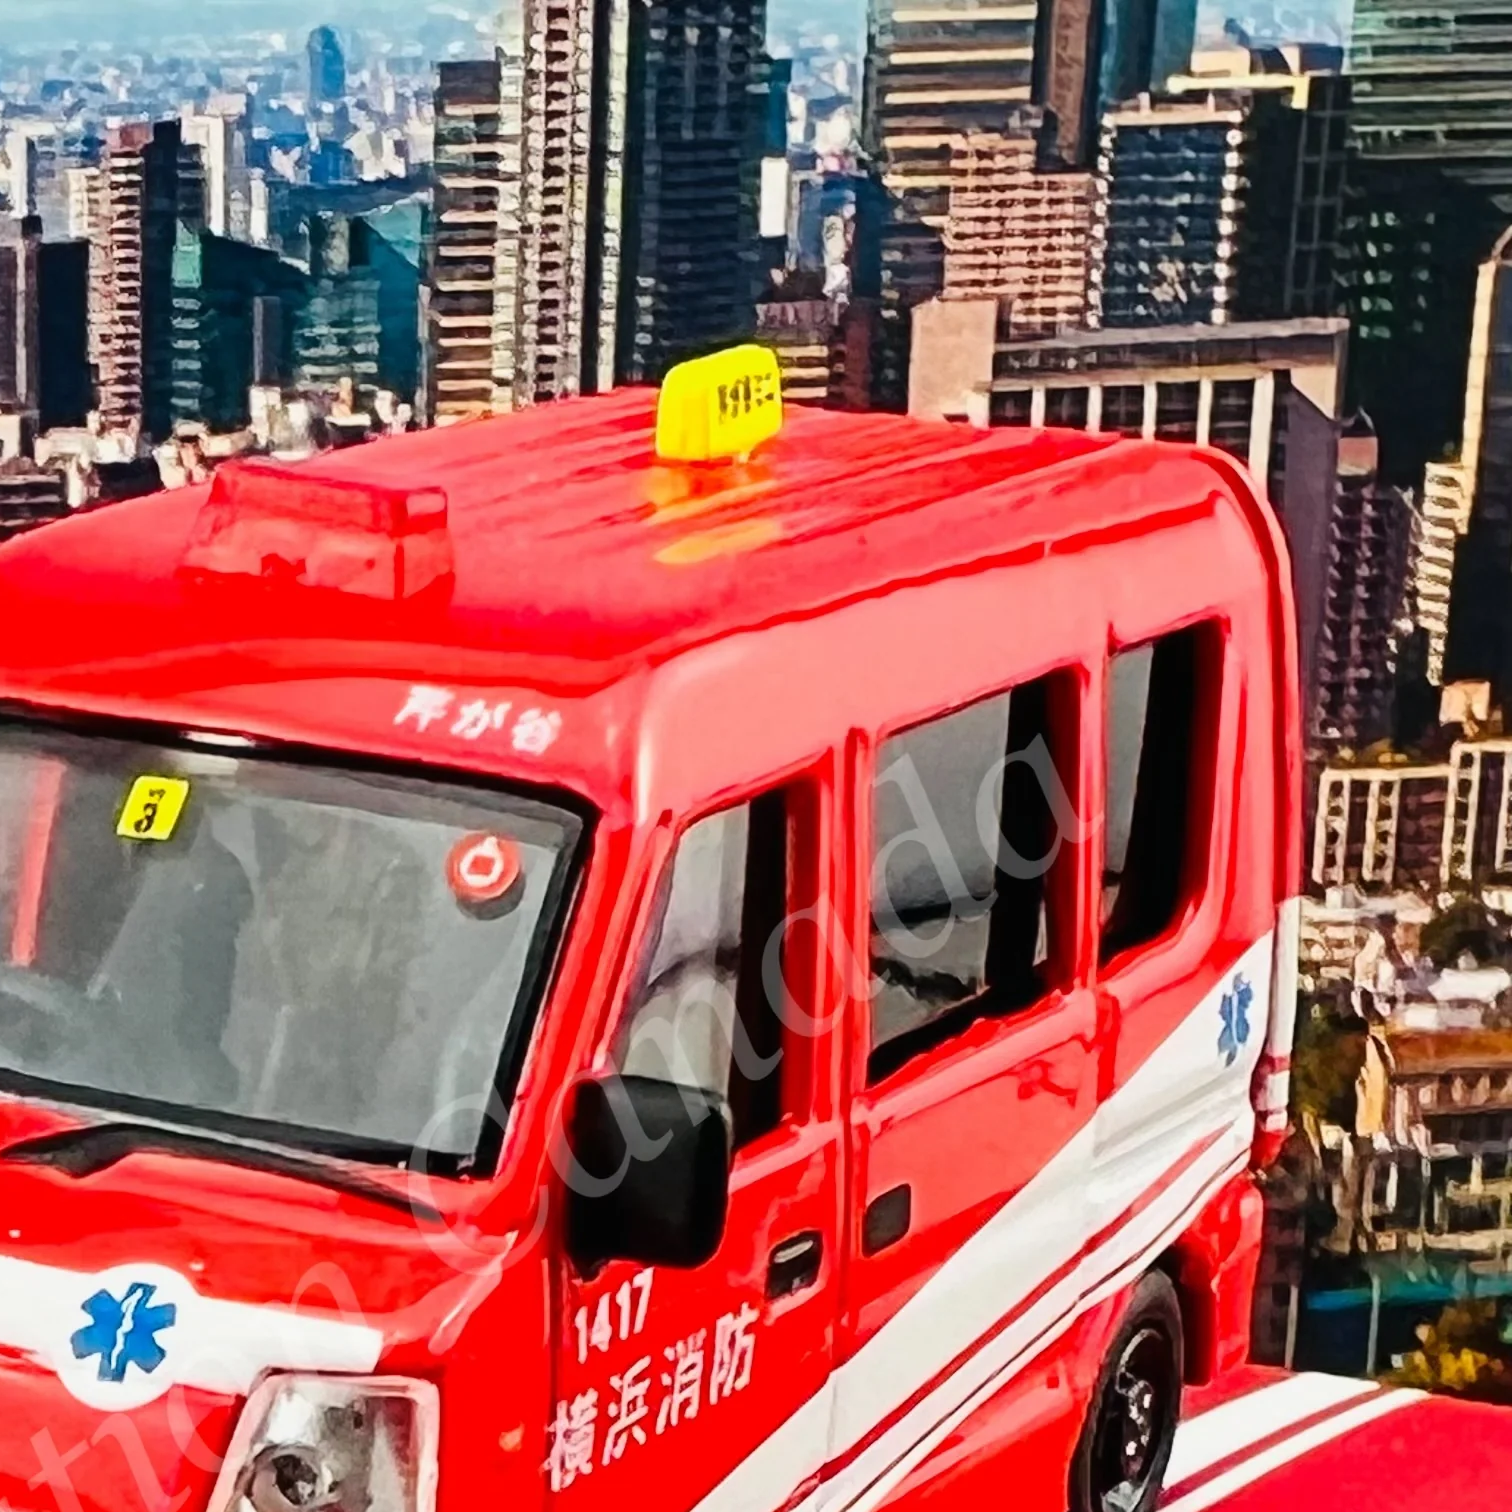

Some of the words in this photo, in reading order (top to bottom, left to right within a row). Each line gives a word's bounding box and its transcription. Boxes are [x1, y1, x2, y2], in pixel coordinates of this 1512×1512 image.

[575, 1266, 654, 1364] 1417
[541, 1302, 760, 1492] 横浜消防
